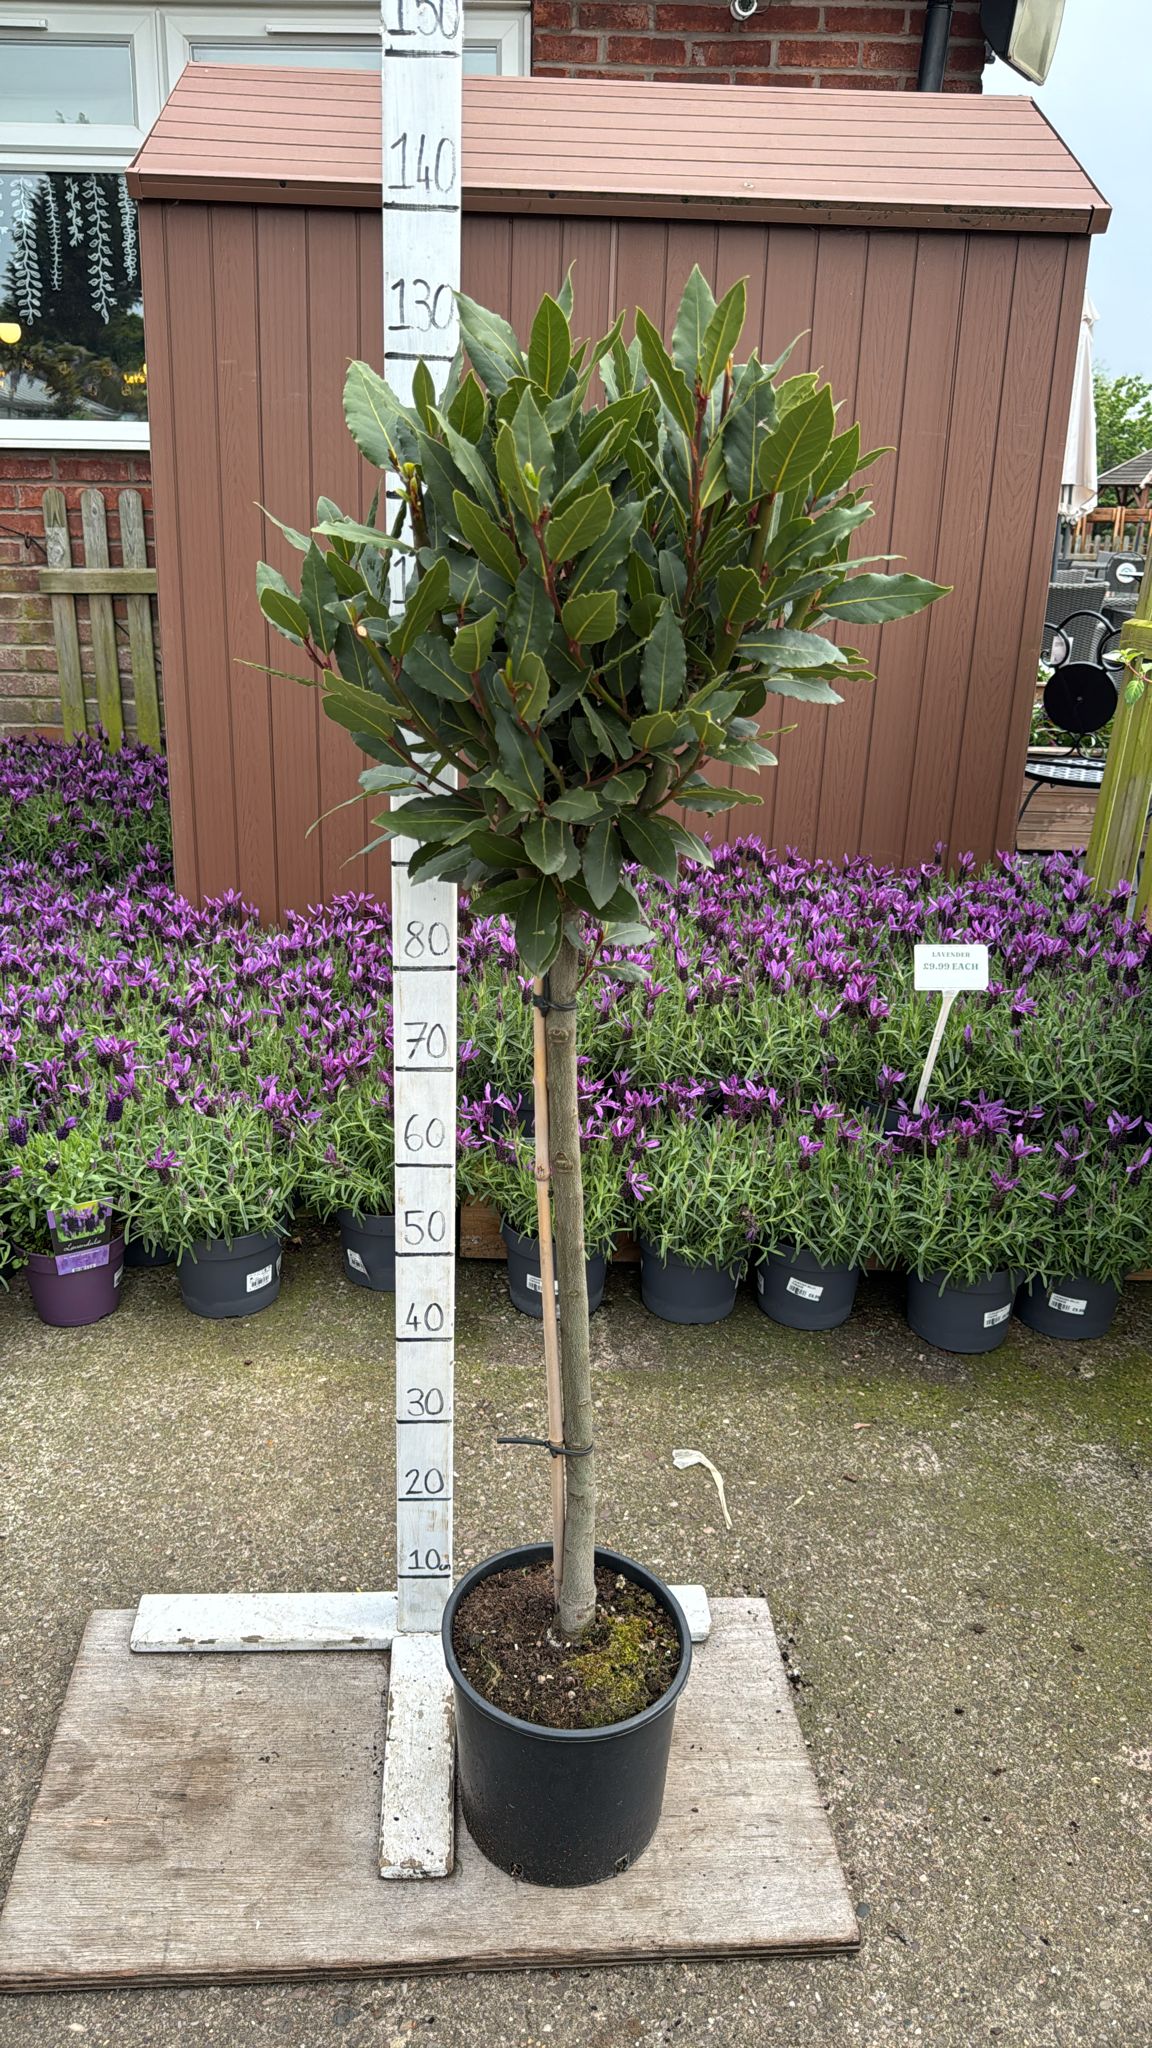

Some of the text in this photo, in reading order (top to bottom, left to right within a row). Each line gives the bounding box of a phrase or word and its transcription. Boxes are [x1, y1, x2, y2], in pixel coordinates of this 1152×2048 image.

[387, 0, 459, 39] 150
[388, 132, 456, 193] 140
[388, 278, 454, 332] 130
[404, 920, 450, 959] 80
[922, 962, 979, 971] £9.99 EACH
[404, 1022, 448, 1060] 70
[404, 1114, 446, 1151] 60
[404, 1210, 446, 1245] 50
[405, 1303, 444, 1332] 40
[406, 1387, 445, 1417] 30
[405, 1468, 445, 1496] 20
